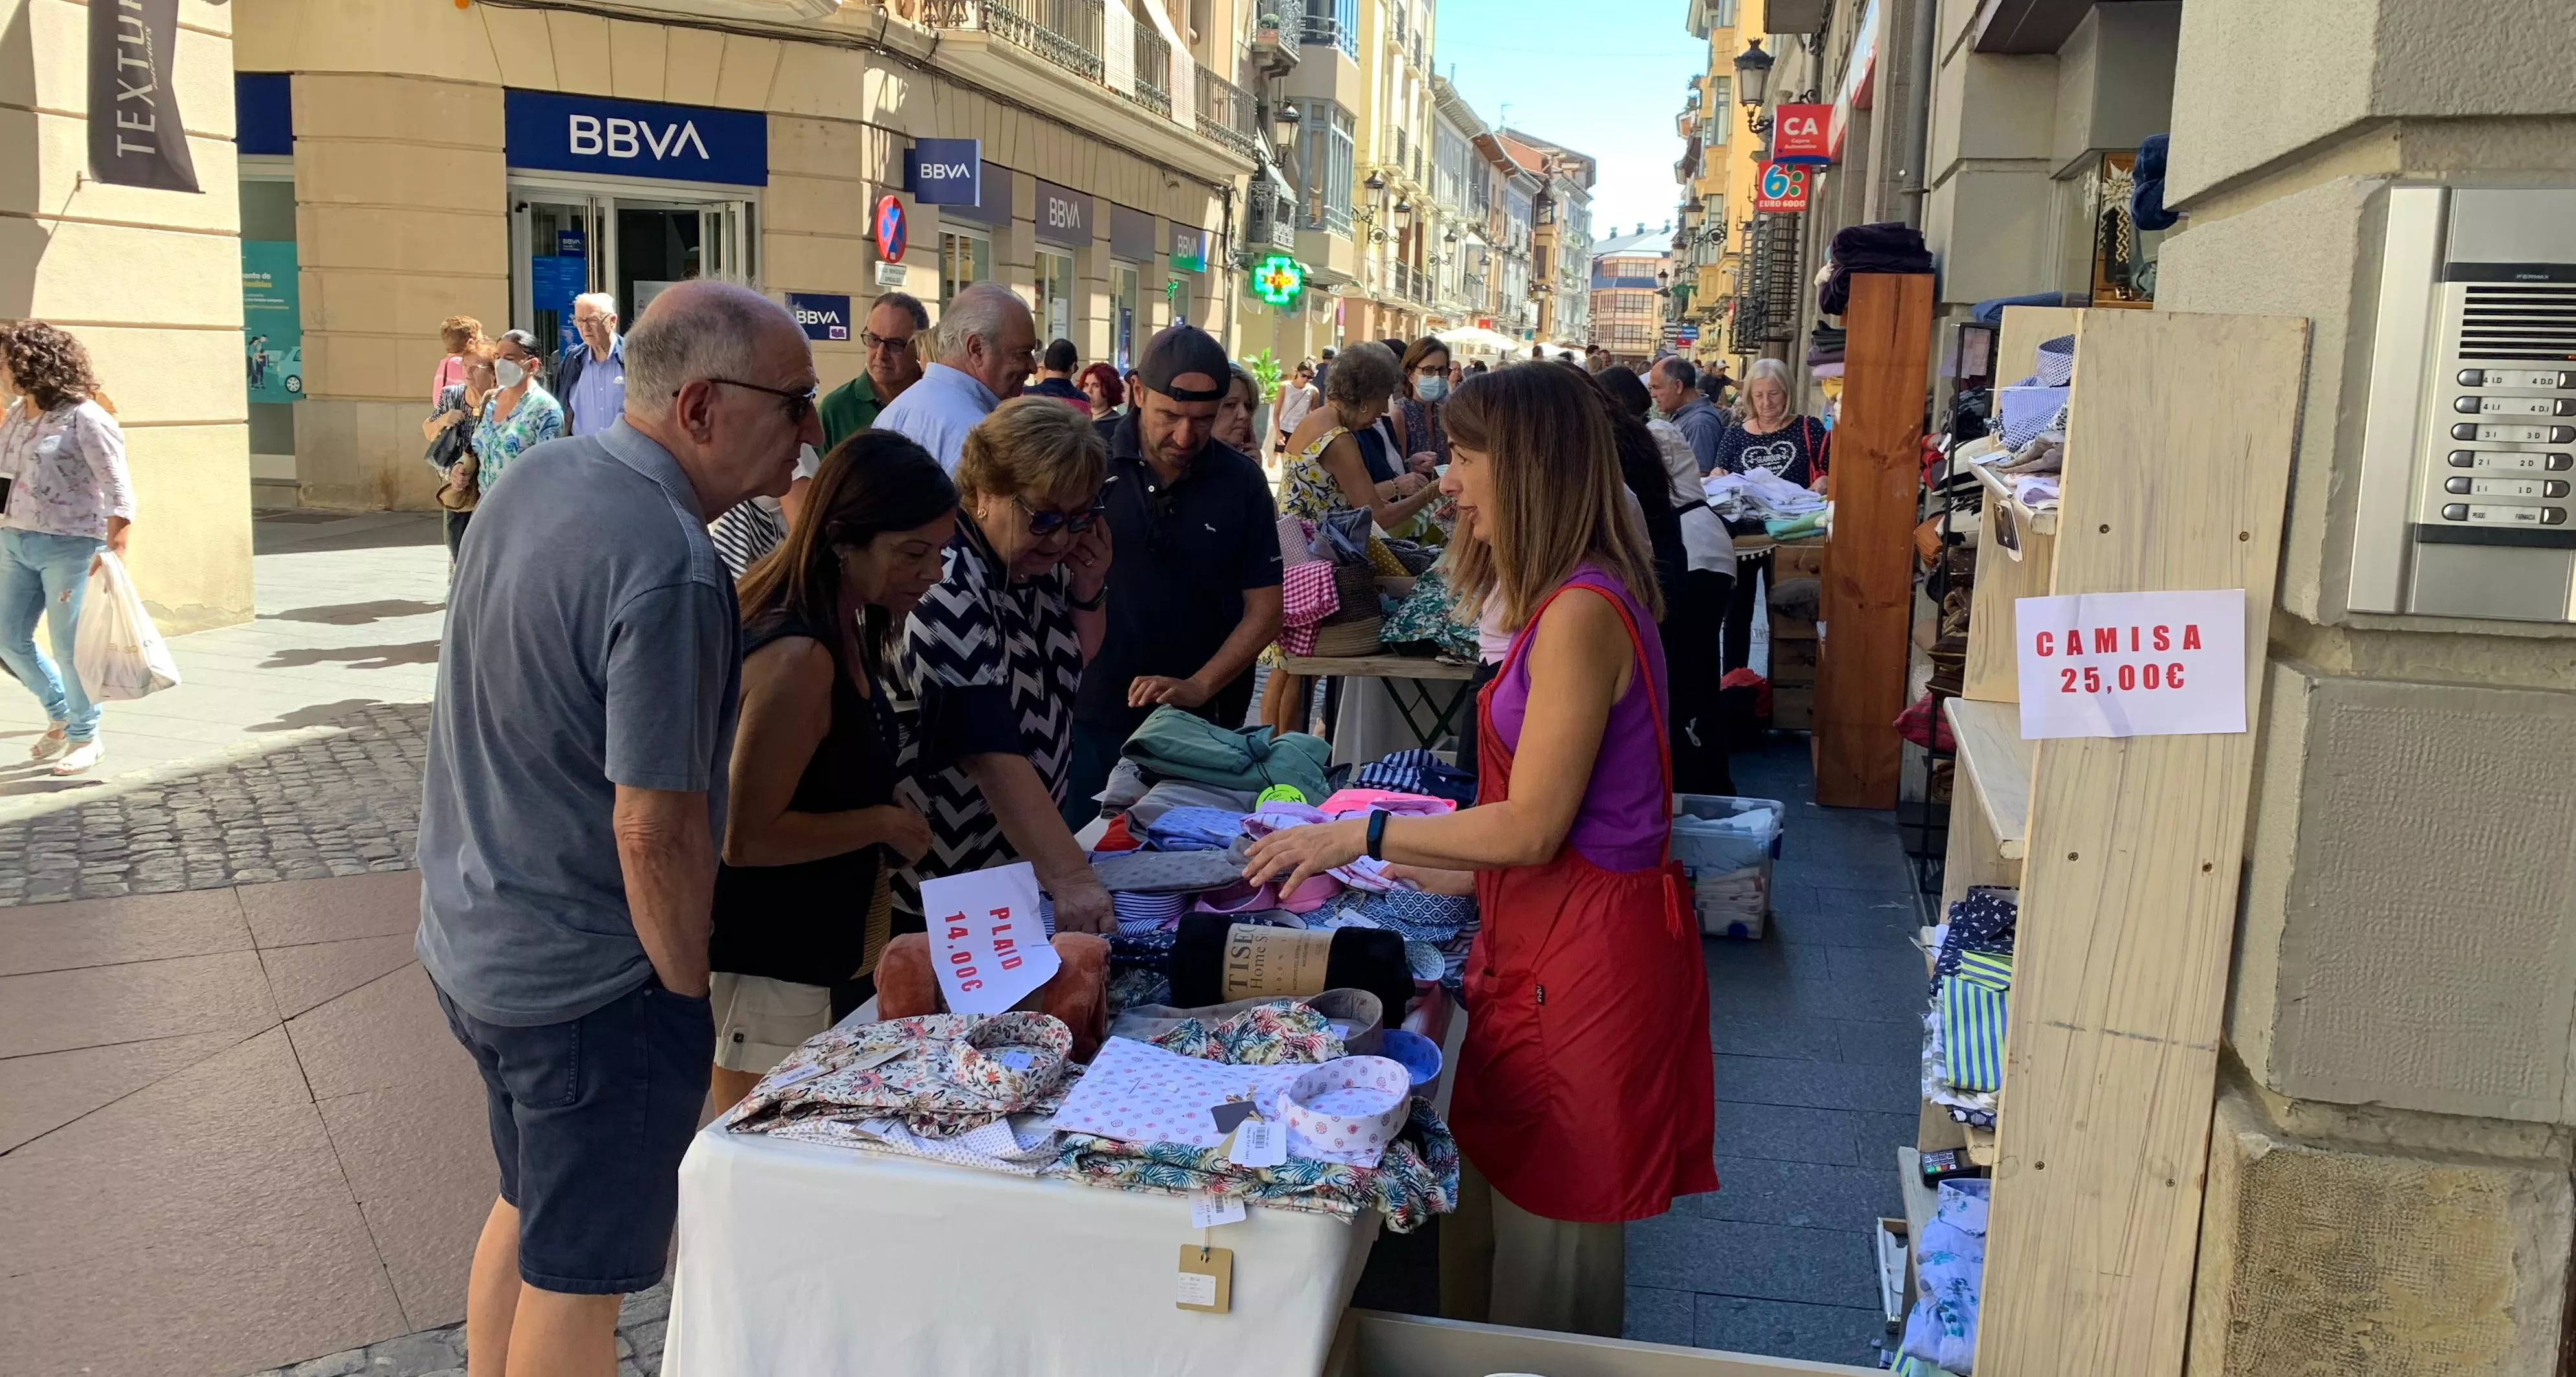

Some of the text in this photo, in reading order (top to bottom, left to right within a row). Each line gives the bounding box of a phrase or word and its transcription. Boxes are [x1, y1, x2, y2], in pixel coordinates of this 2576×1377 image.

[117, 0, 155, 158] TEXTU
[570, 114, 710, 161] BBVA
[1784, 117, 1819, 135] CA
[920, 162, 970, 179] BBVA
[1049, 196, 1081, 229] BBVA
[1177, 234, 1198, 258] BBVA
[796, 310, 840, 324] BBVA
[2036, 624, 2202, 657] CAMISA
[2061, 662, 2185, 695] 25,00€
[945, 910, 983, 992] 14,00€
[989, 906, 1023, 970] PLAID
[1250, 946, 1266, 990] Home
